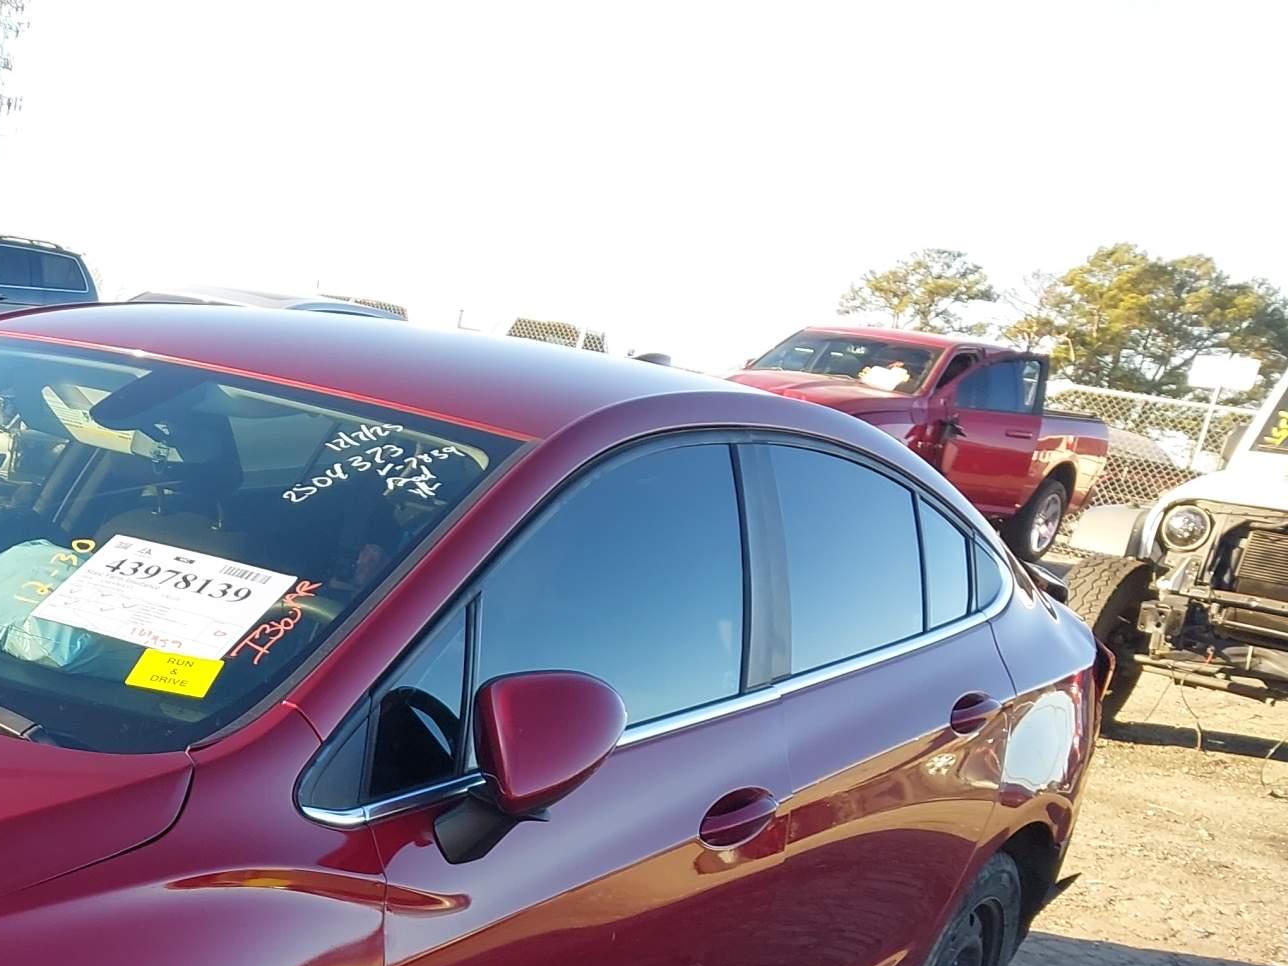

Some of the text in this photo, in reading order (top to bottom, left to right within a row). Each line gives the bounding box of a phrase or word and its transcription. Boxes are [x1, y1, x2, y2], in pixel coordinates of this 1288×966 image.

[105, 557, 253, 604] 43978139
[166, 656, 195, 669] RUN
[149, 673, 190, 688] DRIVE
